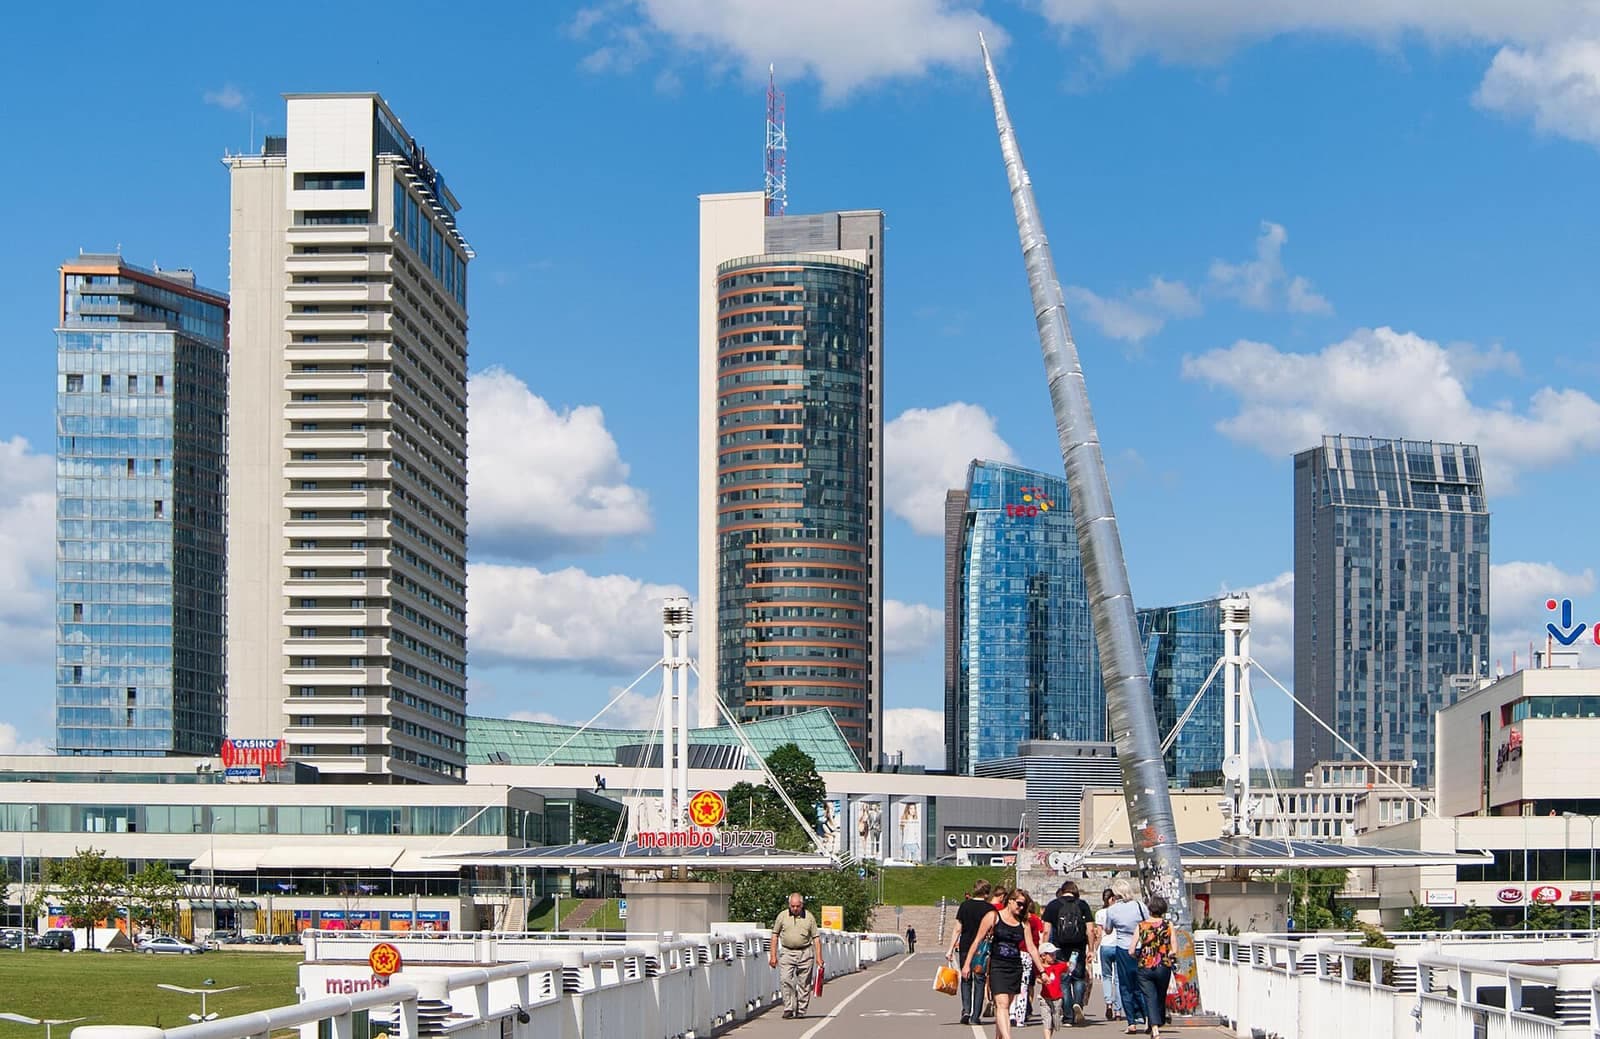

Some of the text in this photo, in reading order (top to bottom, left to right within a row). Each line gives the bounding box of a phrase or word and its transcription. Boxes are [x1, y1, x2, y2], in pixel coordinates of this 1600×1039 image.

[235, 740, 275, 748] CASINO
[637, 825, 776, 852] mambo pizza
[326, 974, 386, 994] mamb
